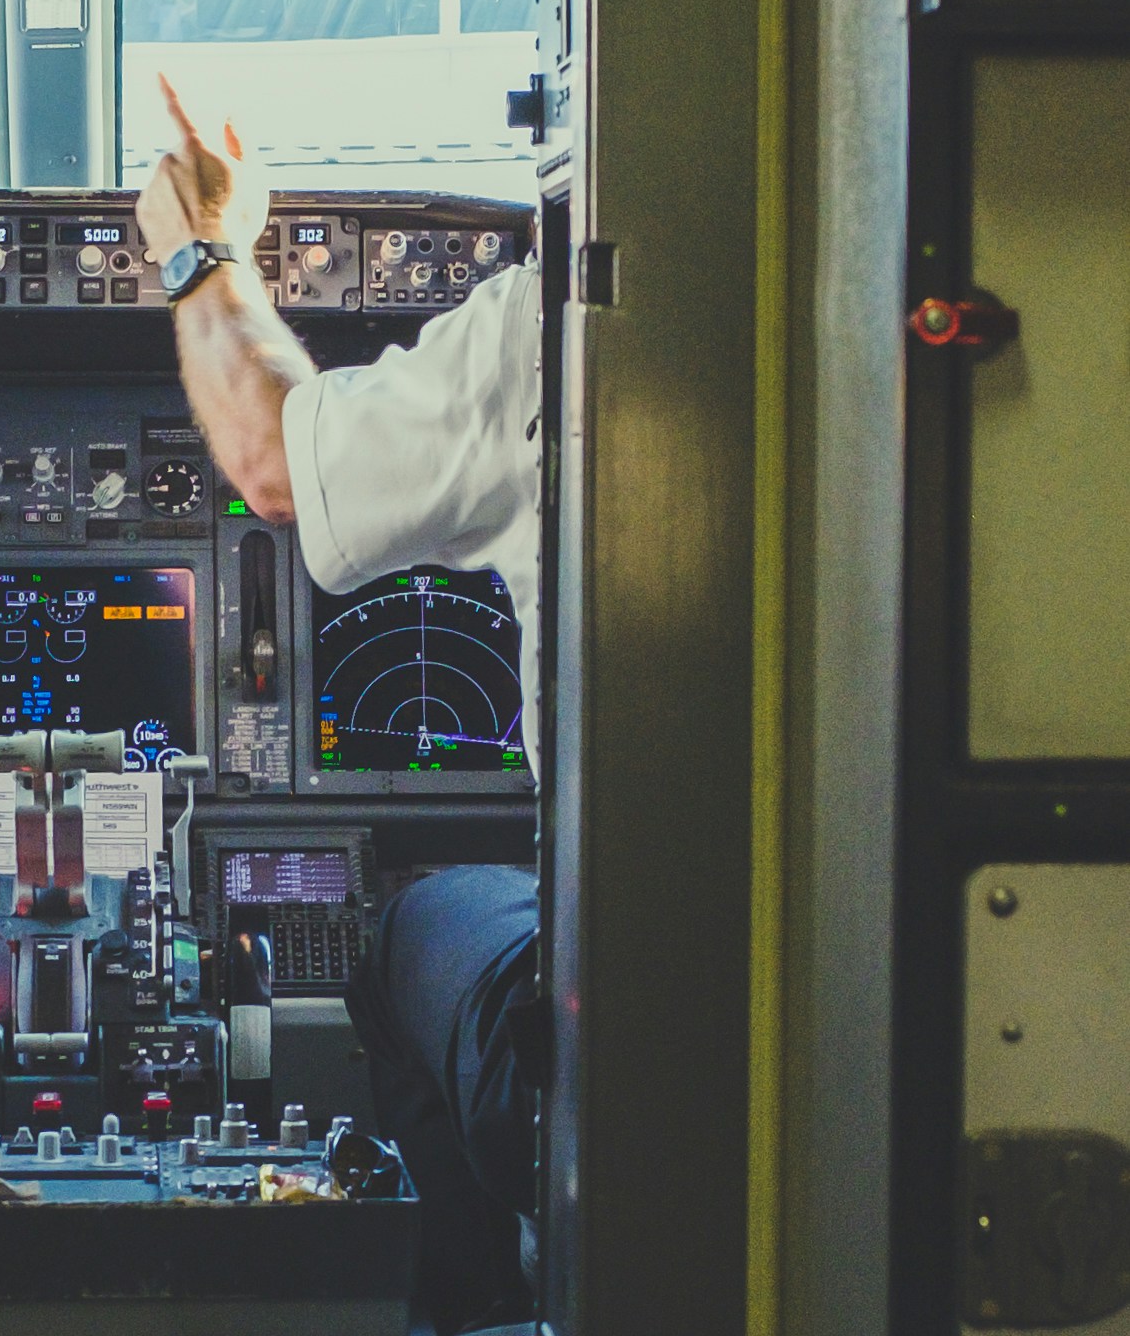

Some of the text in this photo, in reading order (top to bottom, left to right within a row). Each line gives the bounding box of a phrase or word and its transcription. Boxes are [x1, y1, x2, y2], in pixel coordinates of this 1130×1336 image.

[84, 228, 120, 242] 5000
[298, 229, 324, 243] 302
[413, 576, 431, 586] 207
[132, 970, 147, 980] 40
